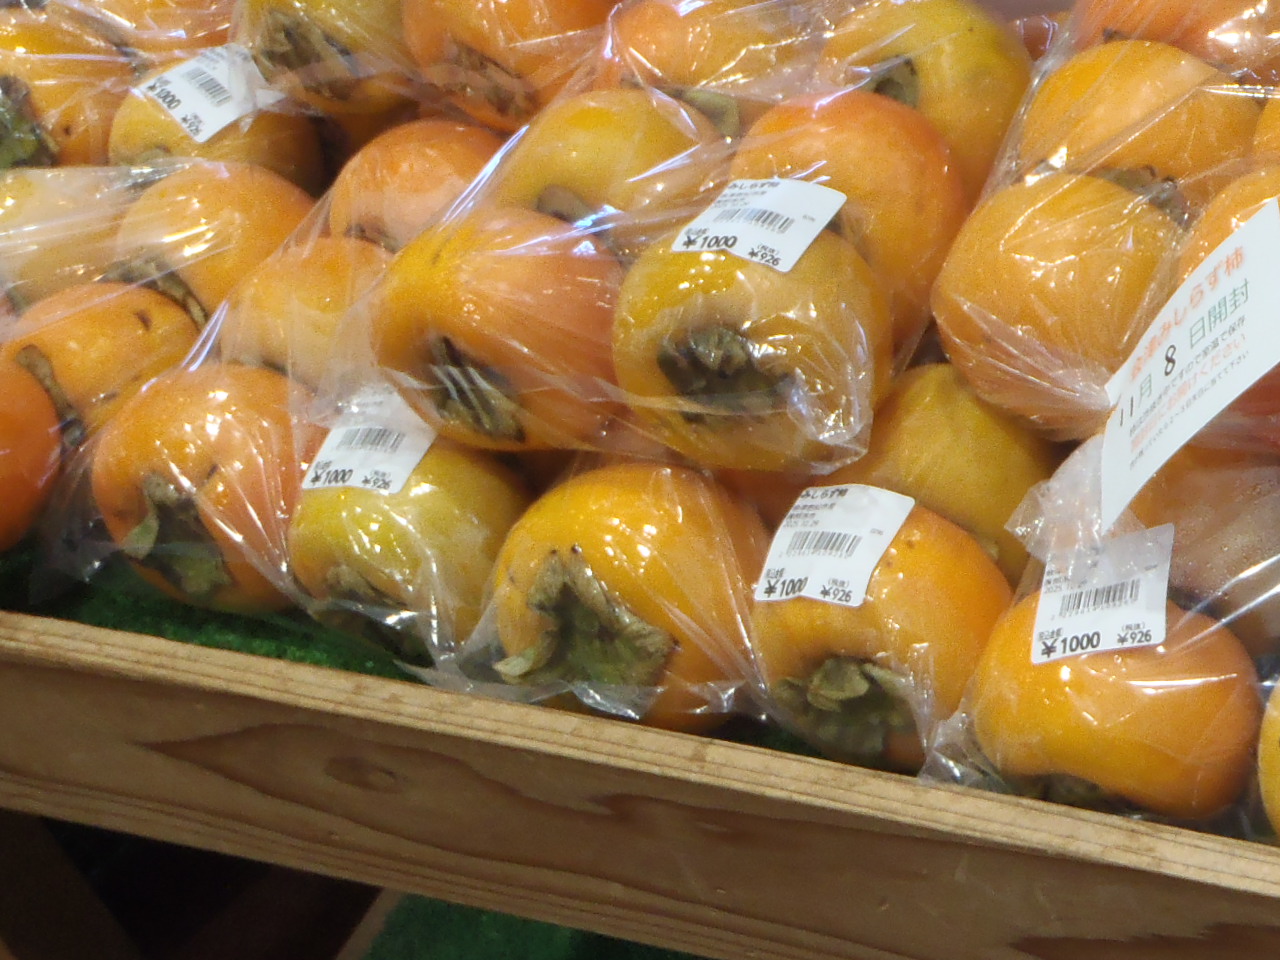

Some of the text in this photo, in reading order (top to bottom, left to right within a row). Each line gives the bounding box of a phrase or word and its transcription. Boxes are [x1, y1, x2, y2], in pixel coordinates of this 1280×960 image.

[683, 235, 782, 267] ¥1000 ¥926
[310, 468, 354, 486] ¥1000
[764, 576, 852, 603] ¥1000 ¥926
[1041, 631, 1101, 659] ¥1000
[1116, 629, 1152, 646] ¥926
